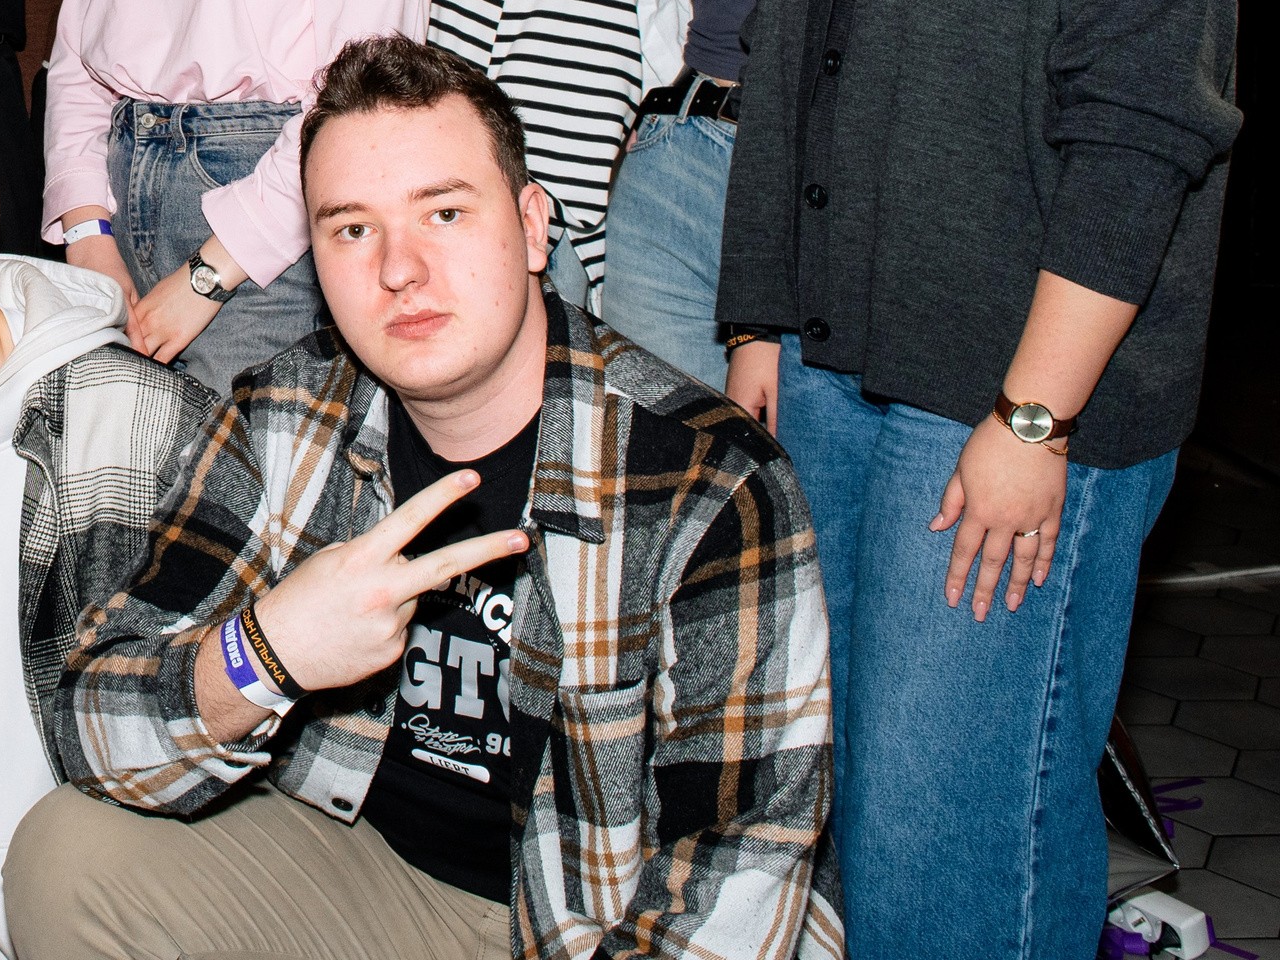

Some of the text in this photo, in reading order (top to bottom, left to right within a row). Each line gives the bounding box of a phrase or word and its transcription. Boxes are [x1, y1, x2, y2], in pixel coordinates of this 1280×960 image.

[242, 608, 287, 684] СЫН ИЛЬИЧА
[400, 624, 511, 723] GT
